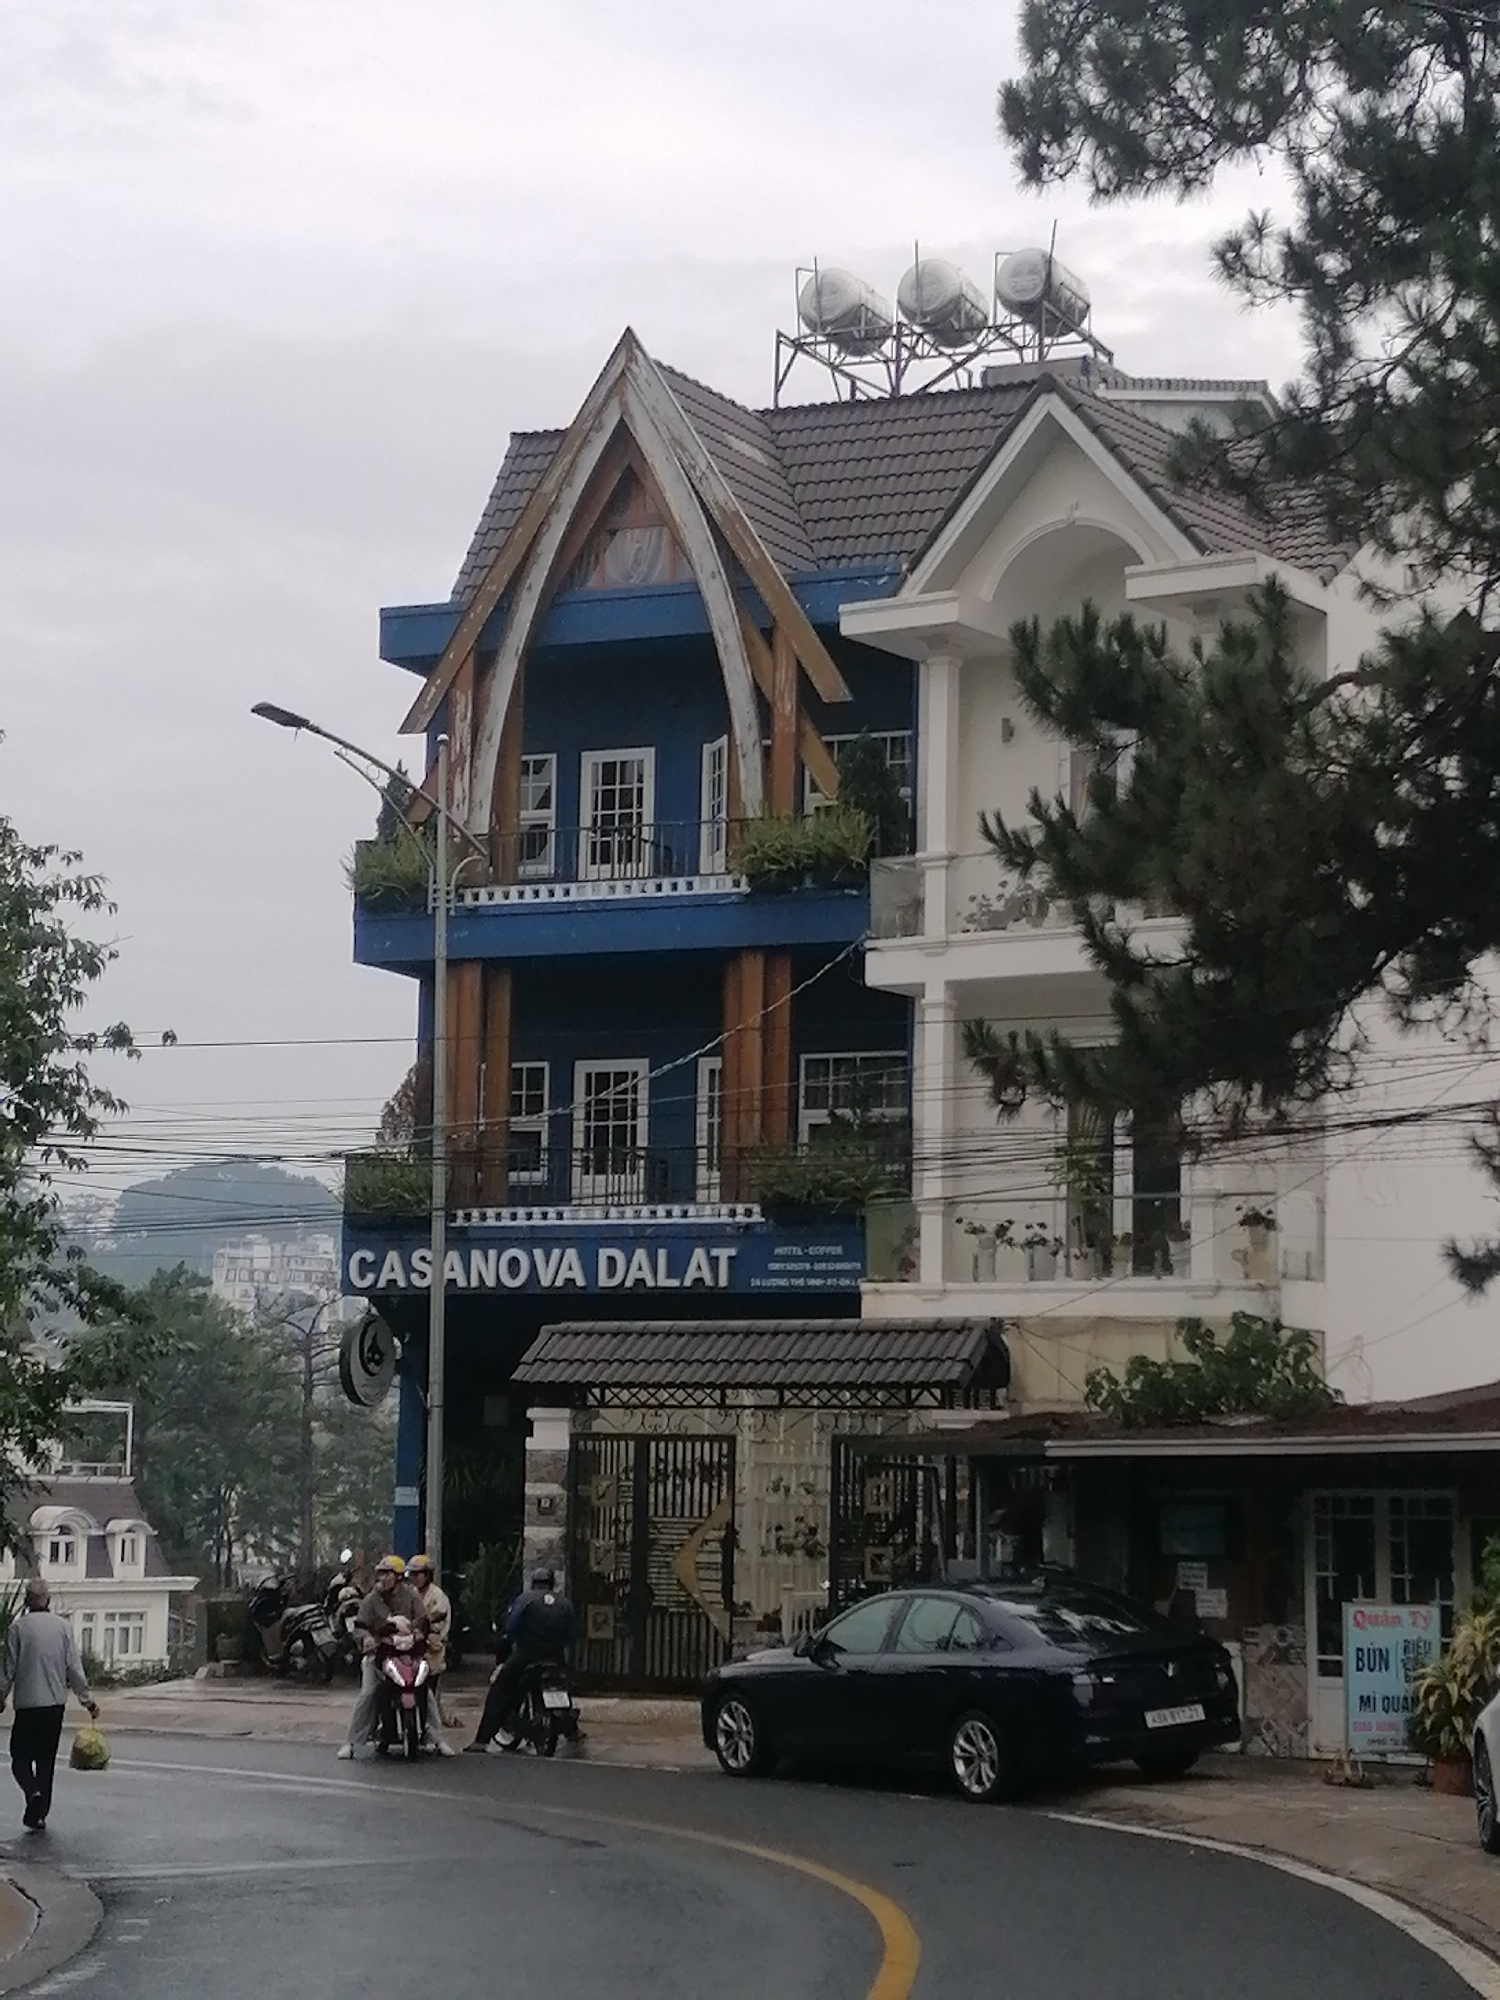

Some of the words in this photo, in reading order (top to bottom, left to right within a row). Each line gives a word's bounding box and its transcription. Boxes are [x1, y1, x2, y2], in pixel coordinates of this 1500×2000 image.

[348, 1248, 587, 1289] CASANOVA
[599, 1248, 737, 1288] DALAT
[1356, 1642, 1390, 1673] BÚN
